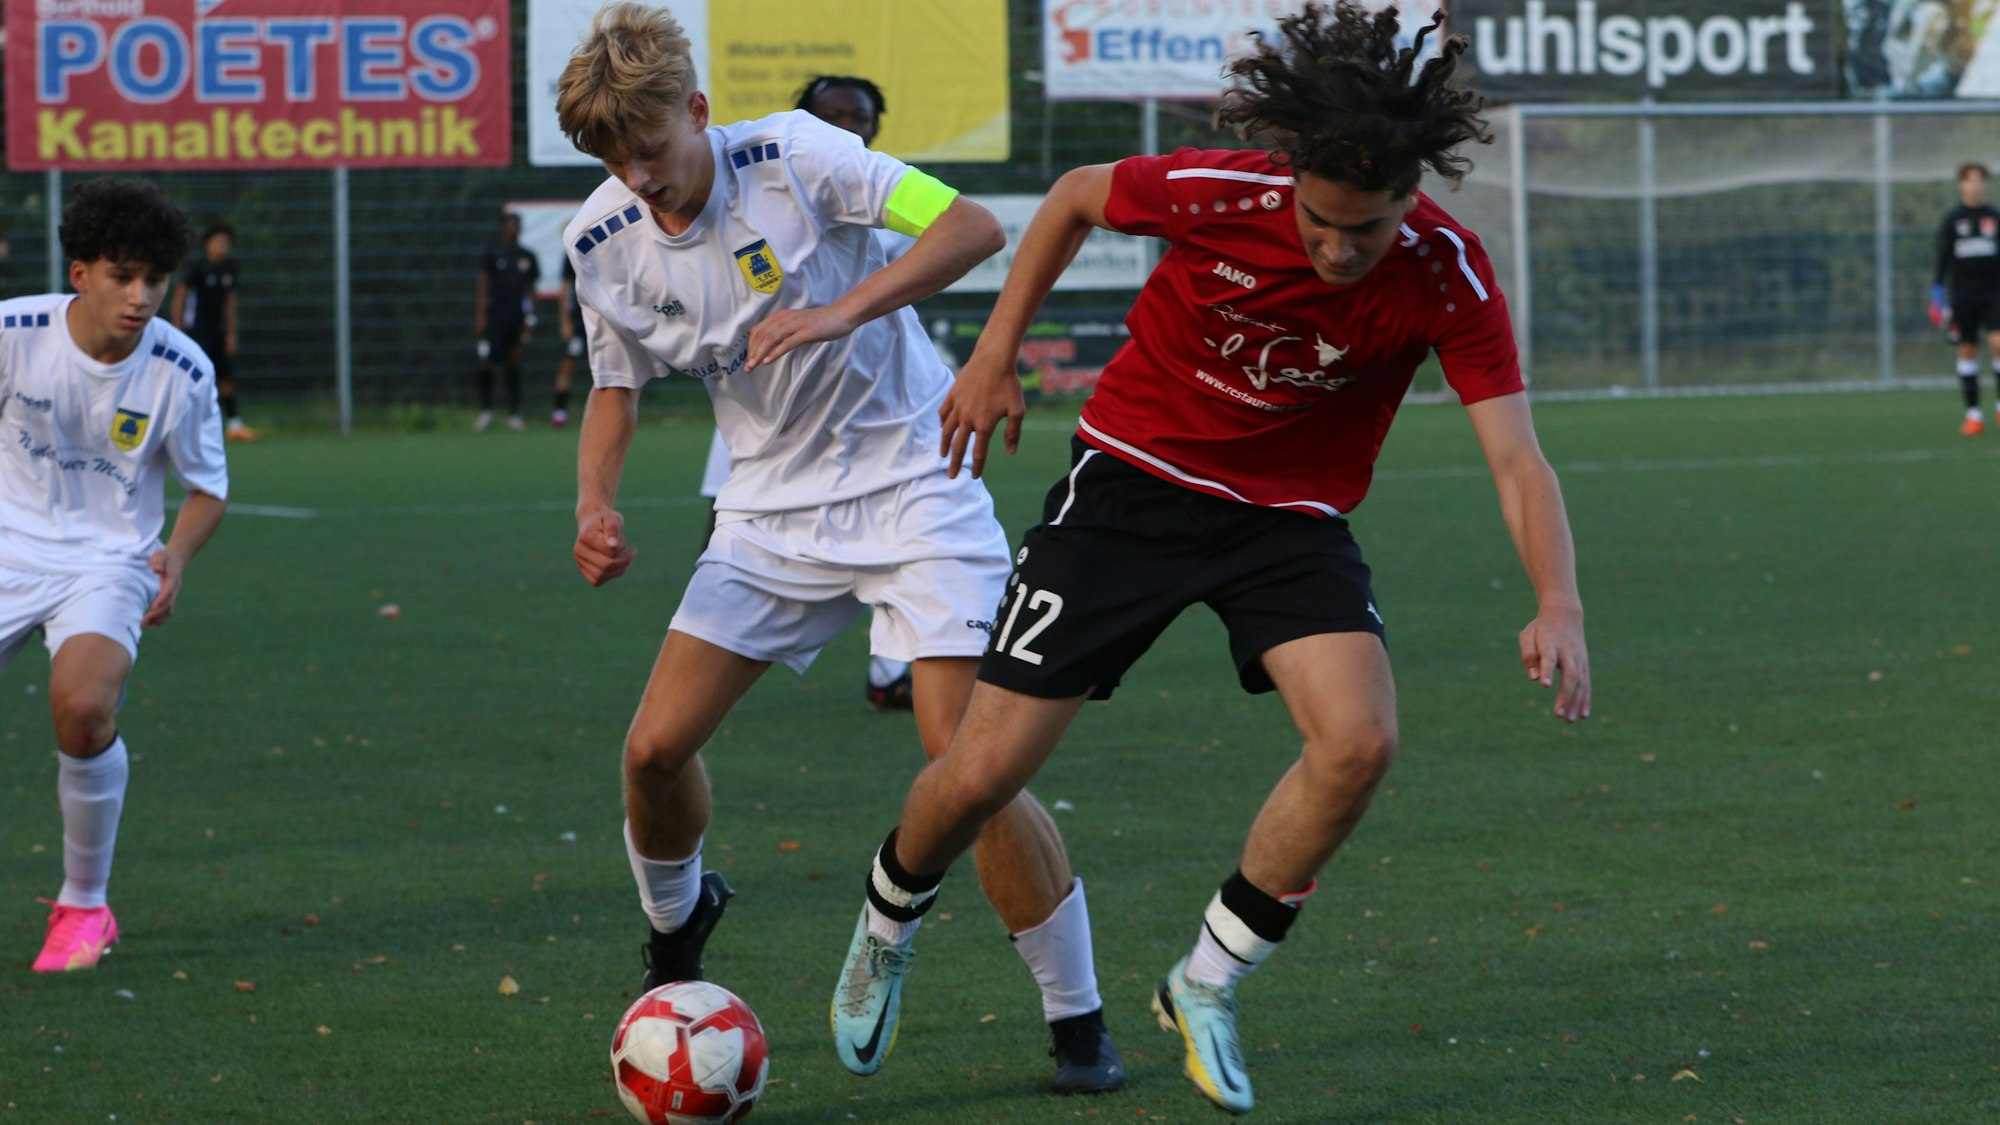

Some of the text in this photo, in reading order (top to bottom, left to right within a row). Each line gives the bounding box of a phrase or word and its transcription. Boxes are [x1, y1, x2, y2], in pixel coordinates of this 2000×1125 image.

[1475, 0, 1815, 88] uhlsport
[37, 106, 481, 161] Kanaltechnik
[1212, 261, 1257, 289] JAKO
[966, 620, 993, 633] cap
[995, 582, 1064, 666] 12
